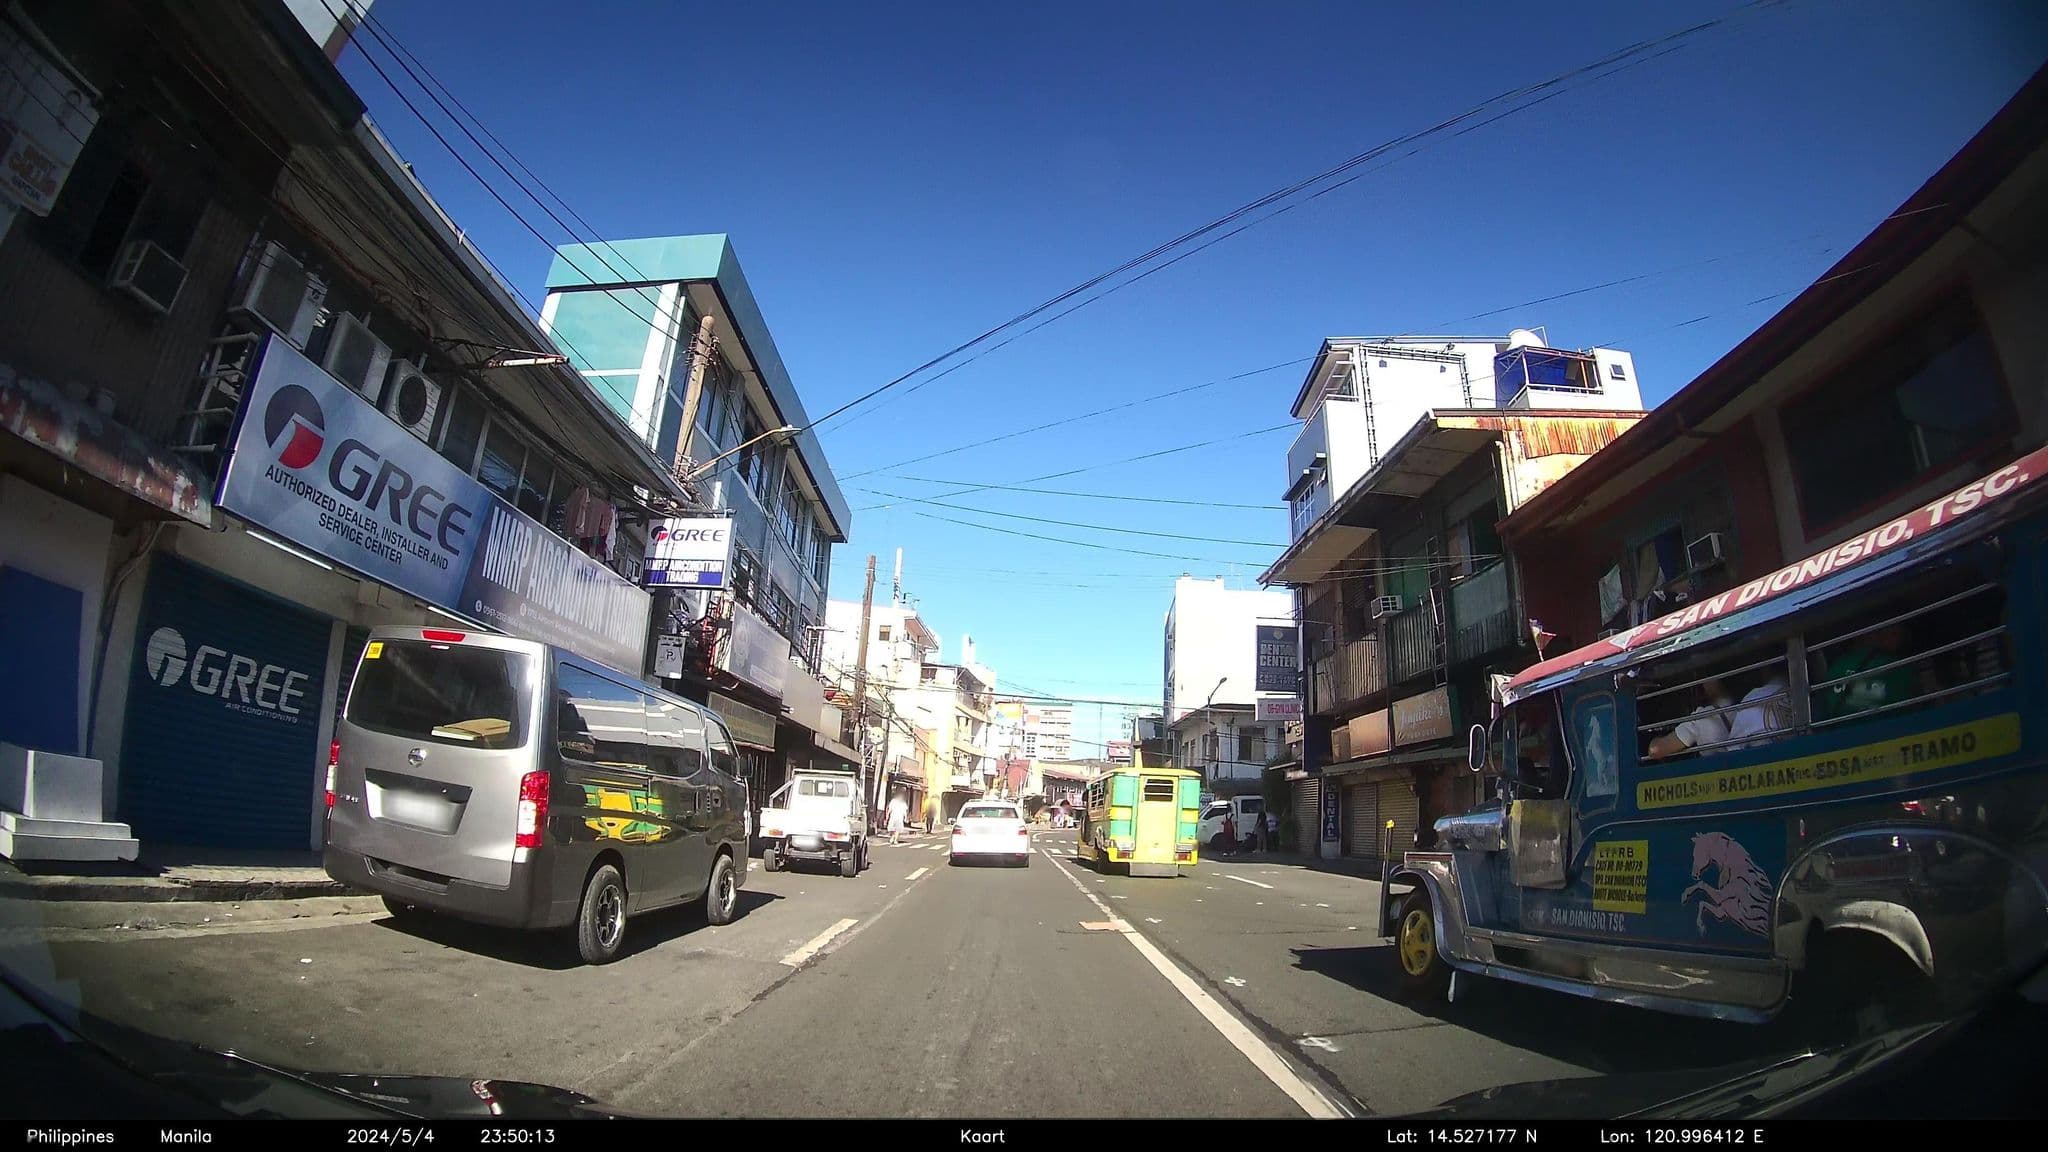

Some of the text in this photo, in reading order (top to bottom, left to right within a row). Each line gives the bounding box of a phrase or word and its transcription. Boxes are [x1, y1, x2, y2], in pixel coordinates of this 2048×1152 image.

[265, 464, 449, 570] AUTHORIZED DEALER, INSTALLER AND
[328, 438, 472, 556] GREE
[318, 513, 402, 566] SERVICE CENTER
[671, 528, 726, 542] GREE
[1657, 463, 2030, 636] SAN DIONISIO, TSC.
[190, 645, 309, 714] GREE
[1260, 655, 1297, 668] CENTER
[1643, 781, 1699, 803] NICHOLS
[1717, 766, 1797, 794] BACLARAN
[1815, 755, 1862, 781] EDSA
[1901, 731, 1976, 765] TRAMO
[1326, 792, 1336, 837] DENTAL
[1551, 908, 1568, 925] SAN
